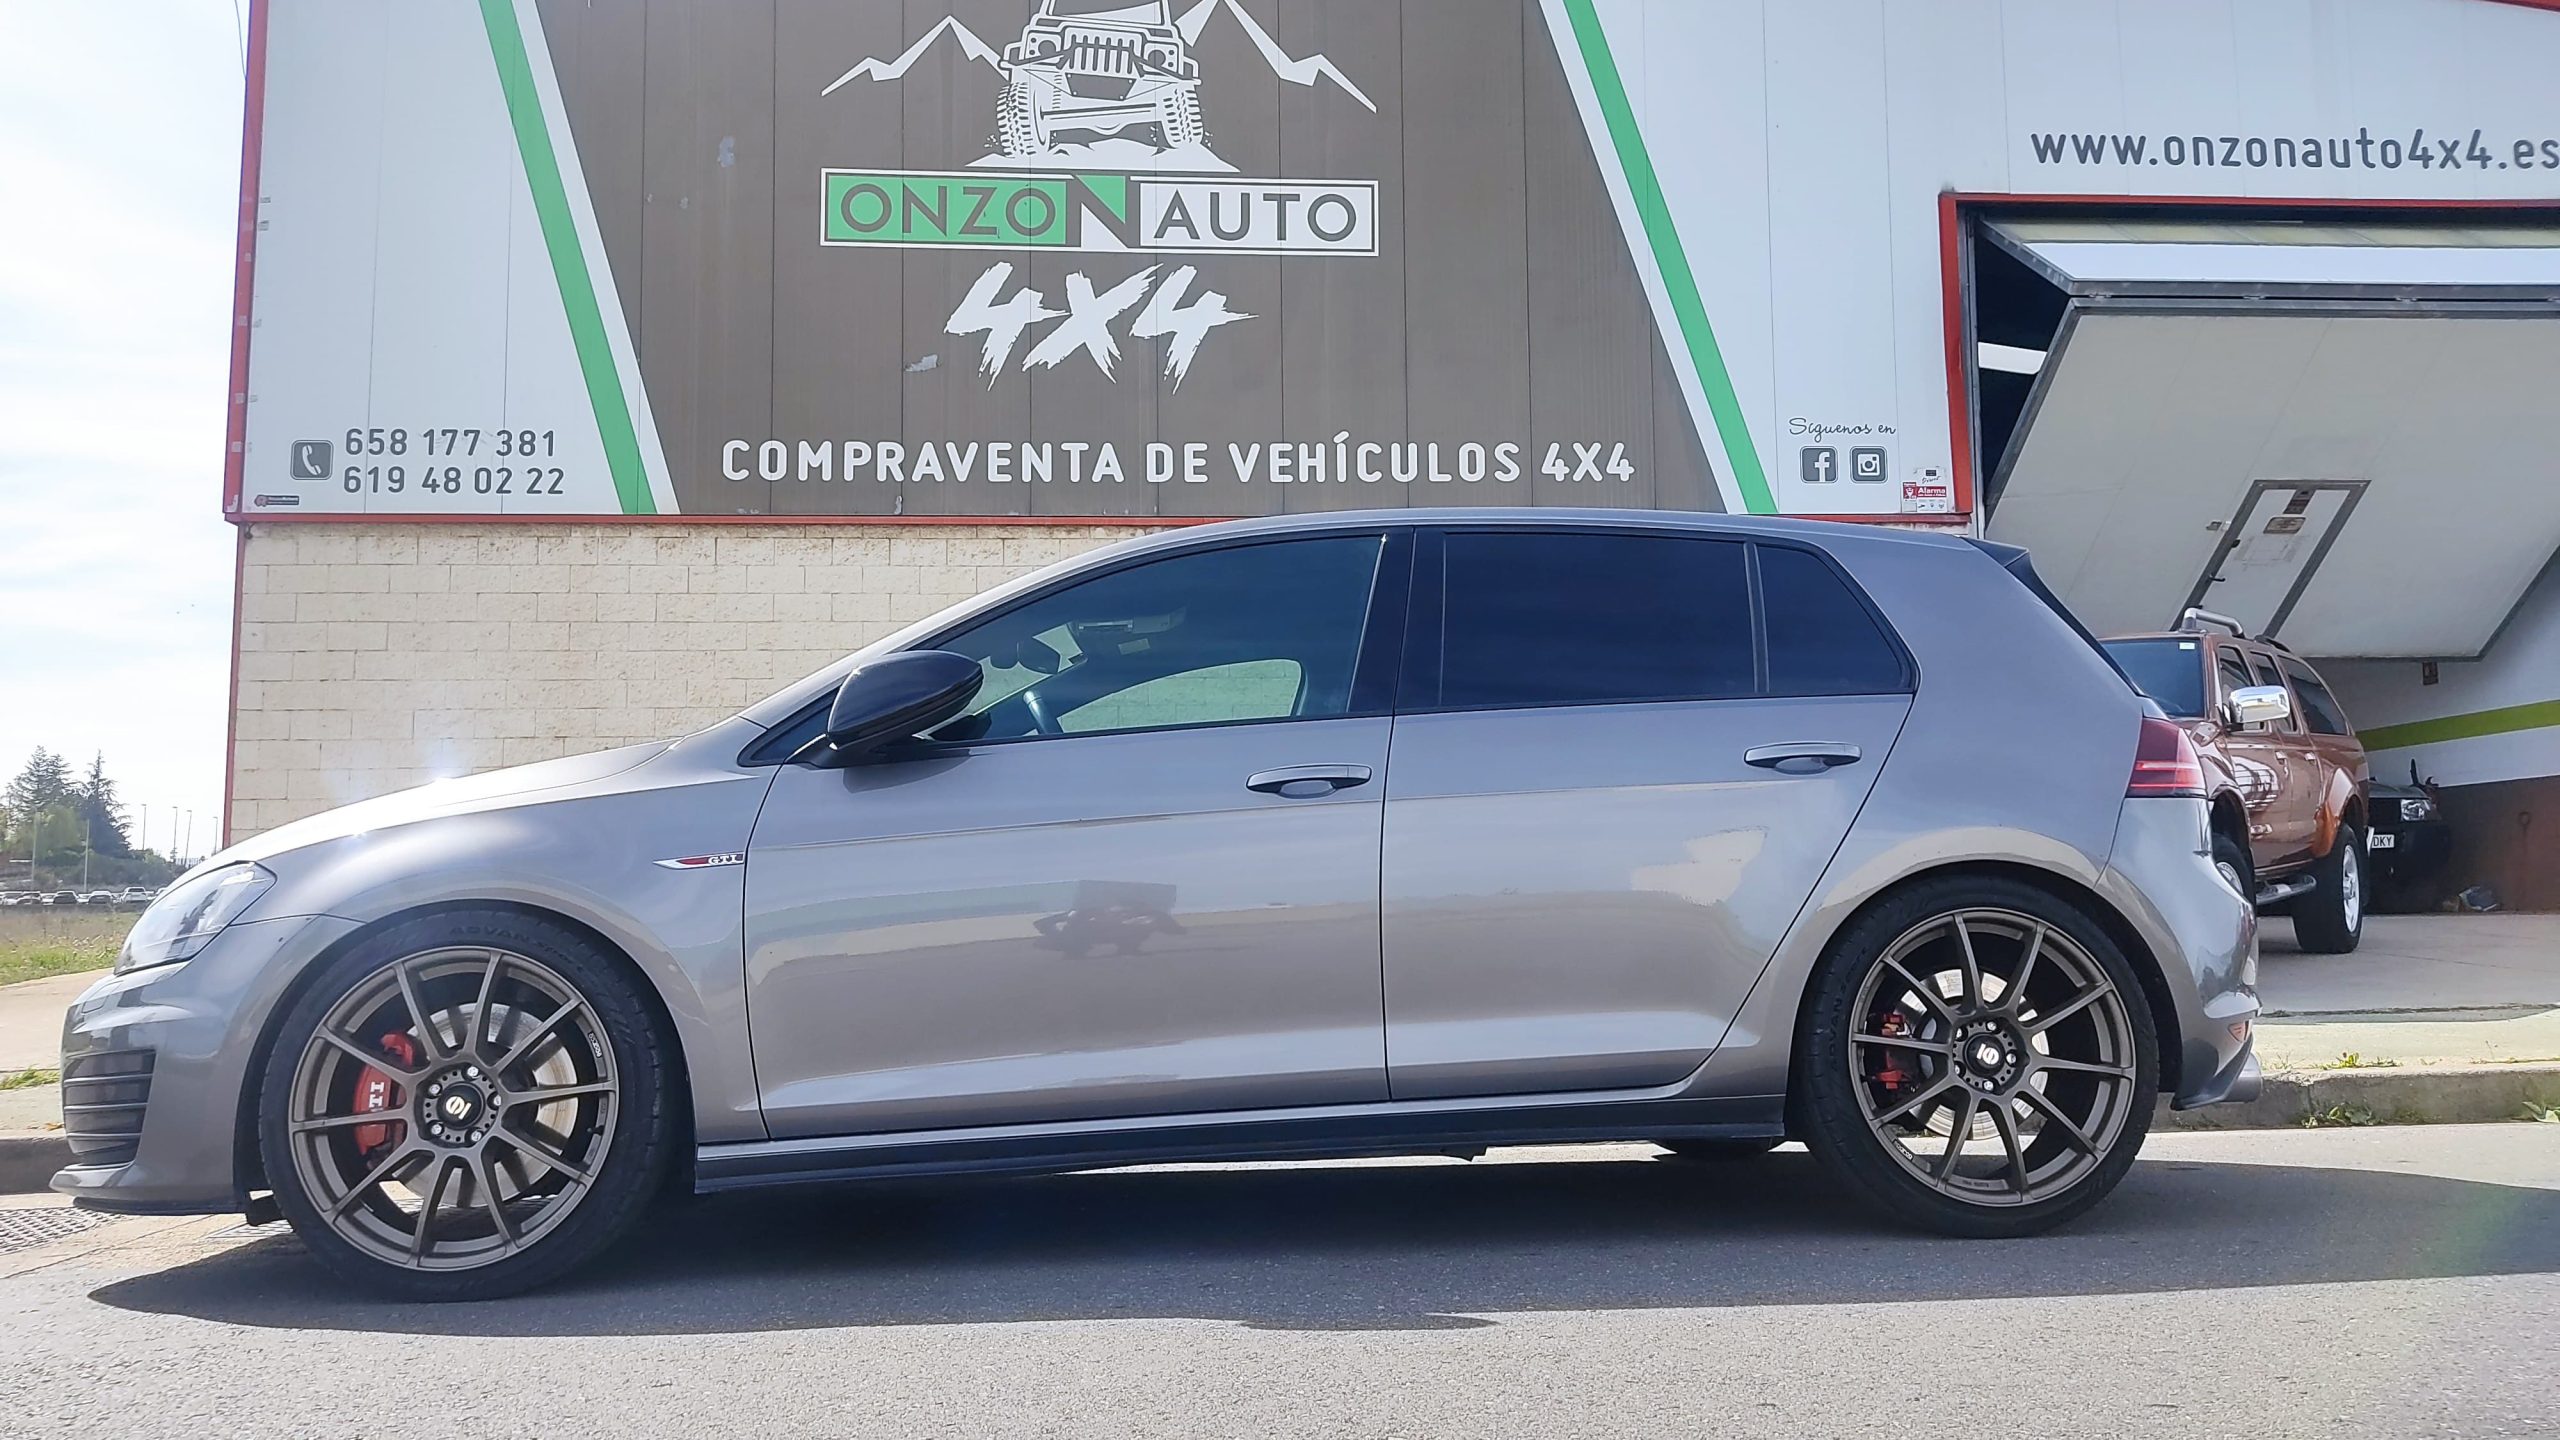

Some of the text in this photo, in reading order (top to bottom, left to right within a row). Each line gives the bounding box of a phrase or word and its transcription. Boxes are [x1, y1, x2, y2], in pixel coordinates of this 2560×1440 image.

[2030, 127, 2560, 170] www.onzonauto4x4.es
[1153, 189, 1357, 242] AUTO
[344, 428, 556, 457] 658 177 381
[1878, 424, 1896, 434] en
[722, 430, 1635, 483] COMPRAVENTA DE VEHÍCULOS 4X4
[343, 466, 565, 495] 619 48 02 22
[2373, 836, 2392, 847] DKY
[708, 854, 738, 865] GTI
[449, 926, 530, 942] ADVAN
